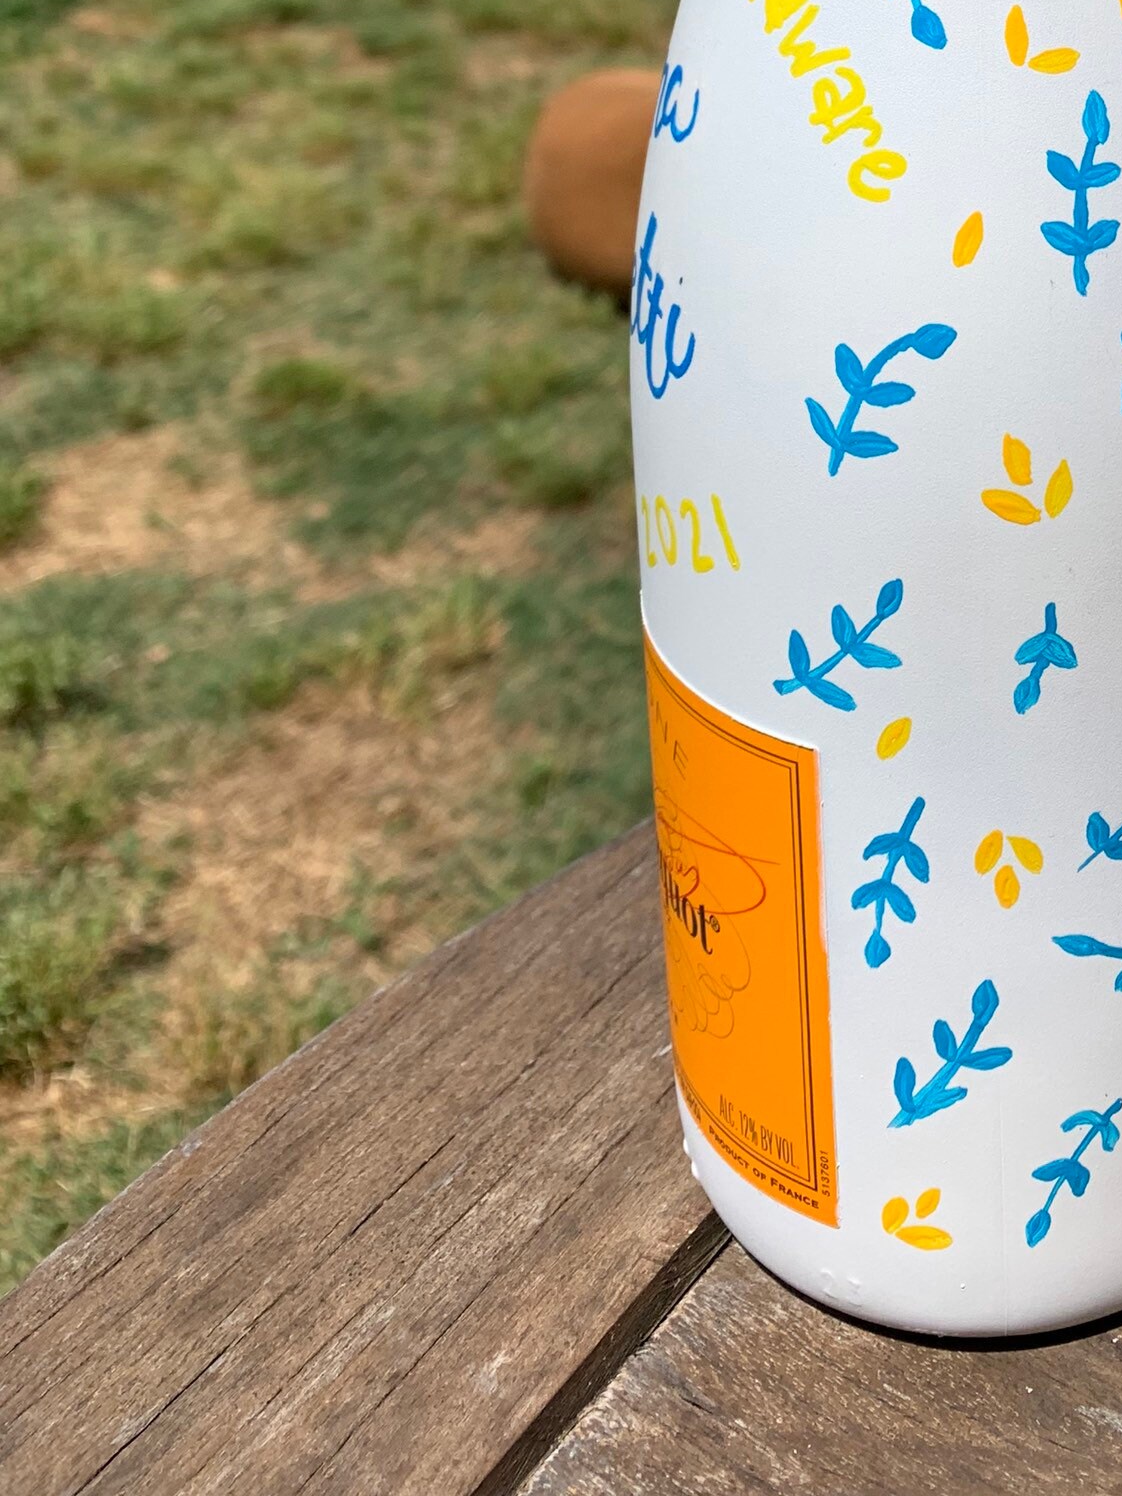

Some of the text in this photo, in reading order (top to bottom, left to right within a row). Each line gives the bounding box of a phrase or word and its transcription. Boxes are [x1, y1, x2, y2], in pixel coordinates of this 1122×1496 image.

[641, 492, 741, 574] 2021
[738, 1110, 759, 1147] 12%
[760, 1124, 773, 1154] BY
[708, 1125, 820, 1210] PRODUCT OF FRANCE
[819, 1150, 831, 1197] 5137601
